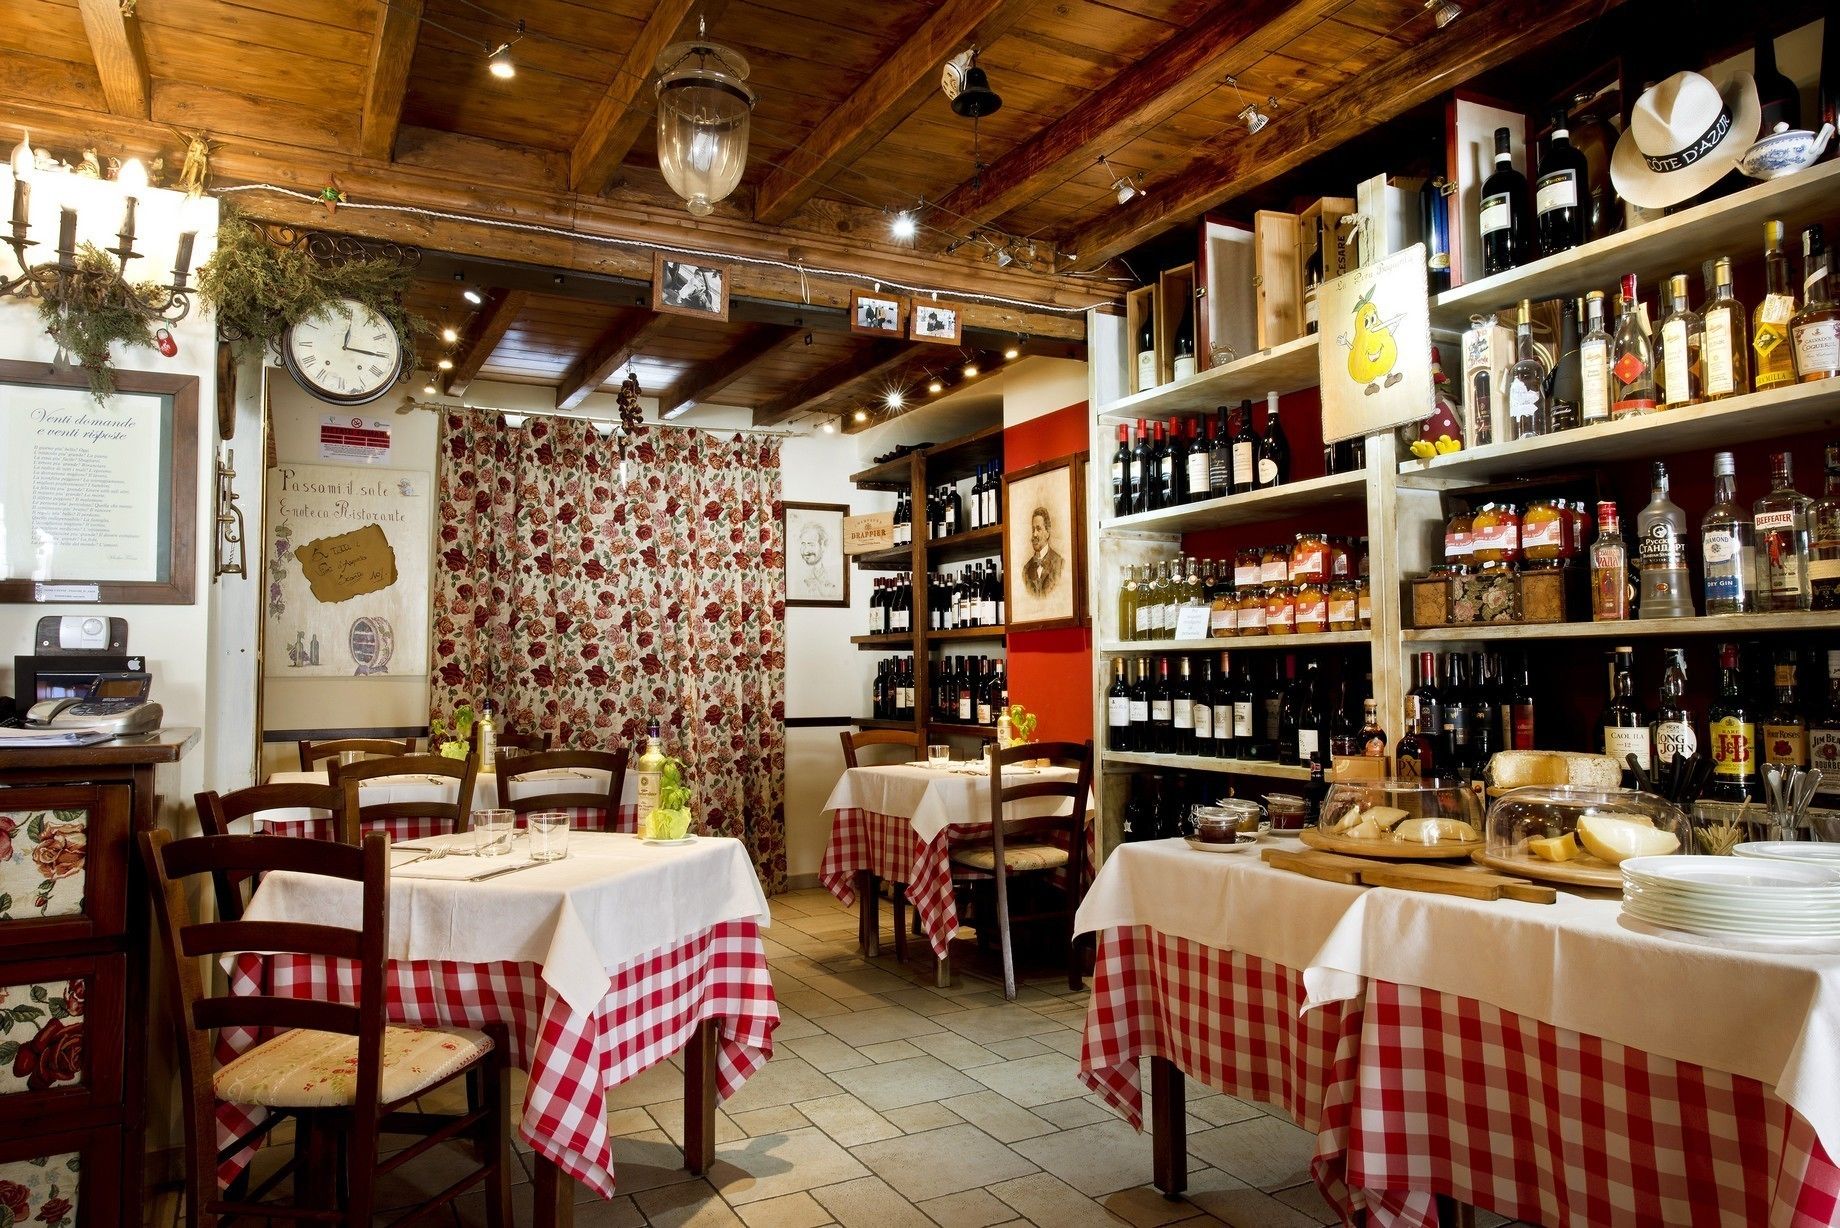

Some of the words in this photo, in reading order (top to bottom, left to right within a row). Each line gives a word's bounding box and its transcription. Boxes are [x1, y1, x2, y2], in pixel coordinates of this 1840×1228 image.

[1646, 157, 1682, 172] CÔTE
[1683, 114, 1730, 164] D'AZUR
[1336, 235, 1346, 277] CESARE
[31, 408, 72, 424] Venti
[74, 414, 136, 428] domande
[47, 428, 80, 437] venti
[82, 430, 127, 444] risposte
[279, 468, 341, 494] Passami
[346, 480, 353, 495] il
[360, 481, 389, 497] sale
[279, 498, 329, 517] Enoteca
[334, 499, 406, 522] Ristorante
[1756, 513, 1792, 526] BEEFEATER
[851, 529, 887, 540] DRAPPIER
[1638, 543, 1685, 554] СТАНДРТ
[1611, 732, 1630, 740] CAOL
[1658, 733, 1685, 745] LONG
[1780, 730, 1801, 740] Roses
[1811, 735, 1825, 748] JIM
[1660, 743, 1695, 755] JOHN
[1715, 734, 1750, 763] J&B
